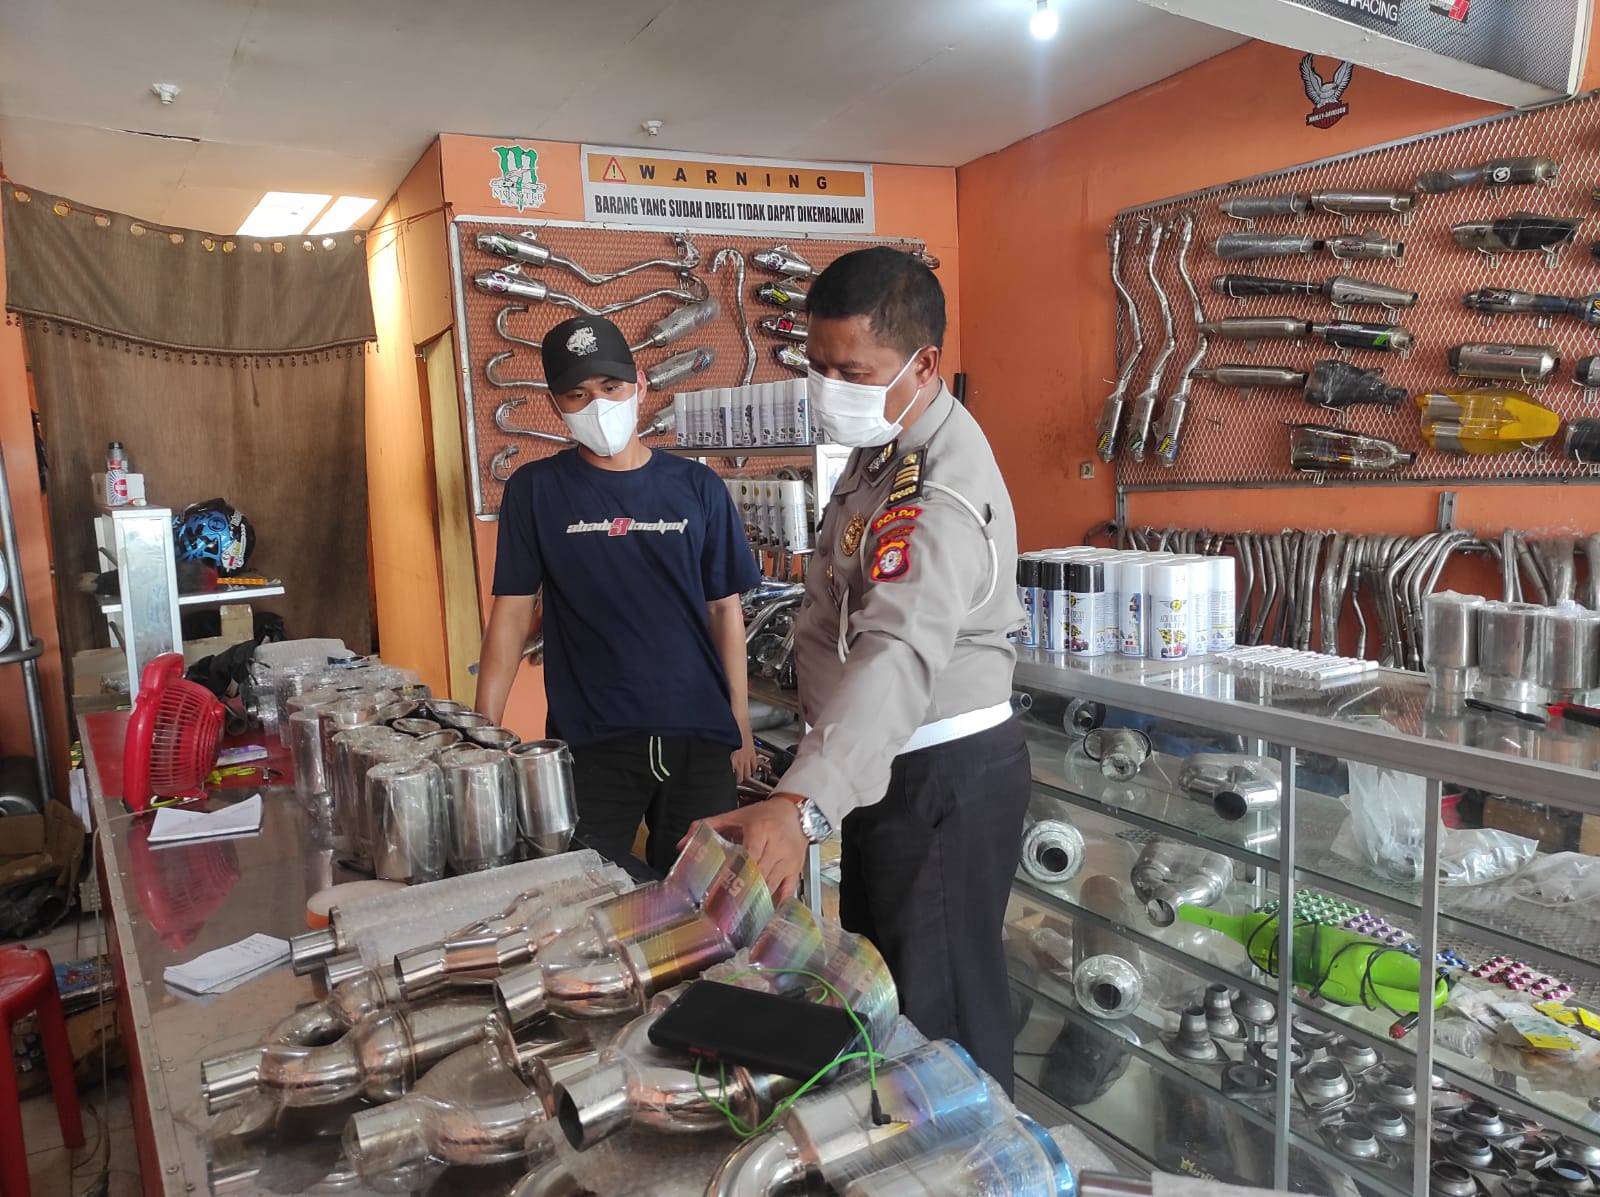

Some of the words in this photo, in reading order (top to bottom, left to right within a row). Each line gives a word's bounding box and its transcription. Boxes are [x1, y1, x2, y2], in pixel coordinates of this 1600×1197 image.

[639, 164, 828, 190] WARNING
[594, 194, 639, 215] BARANG
[640, 197, 667, 217] YANG
[668, 199, 703, 218] SUDAH
[704, 201, 736, 220] DIBELI
[736, 203, 766, 221] TIDAK
[767, 204, 796, 222] DAPAT
[797, 205, 865, 225] DIKEMBALIKAN!
[876, 509, 916, 529] POLDA
